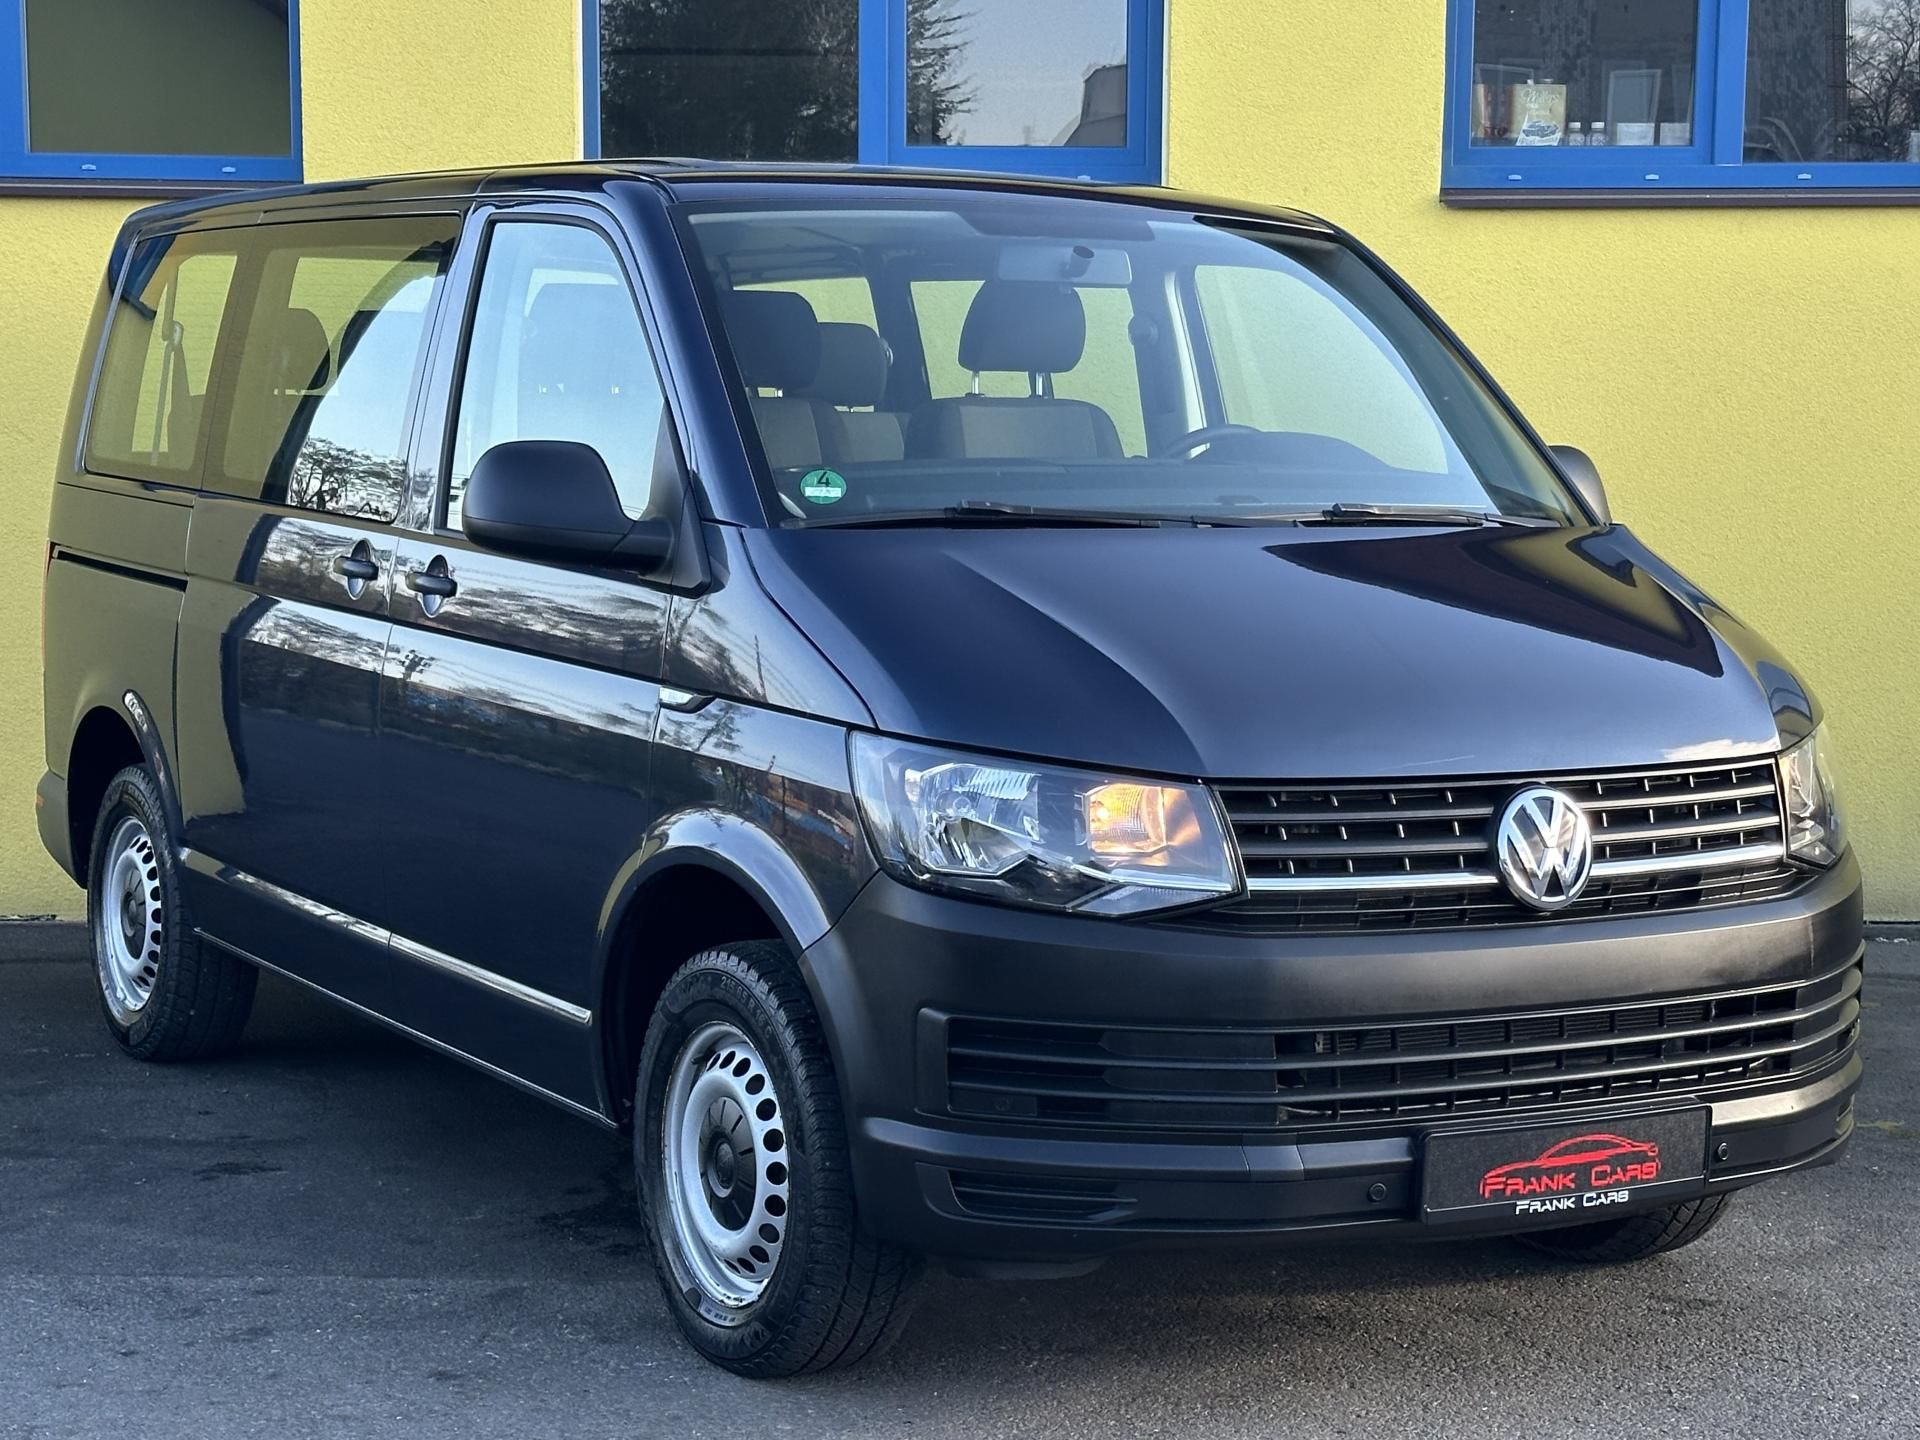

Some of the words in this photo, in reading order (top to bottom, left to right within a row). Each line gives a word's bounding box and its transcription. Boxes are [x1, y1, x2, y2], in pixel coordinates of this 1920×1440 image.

[817, 471, 831, 487] 4
[1484, 1173, 1575, 1198] FRANK
[1591, 1162, 1657, 1186] CARS
[1515, 1197, 1576, 1215] FRANK
[1583, 1190, 1629, 1207] CARS
